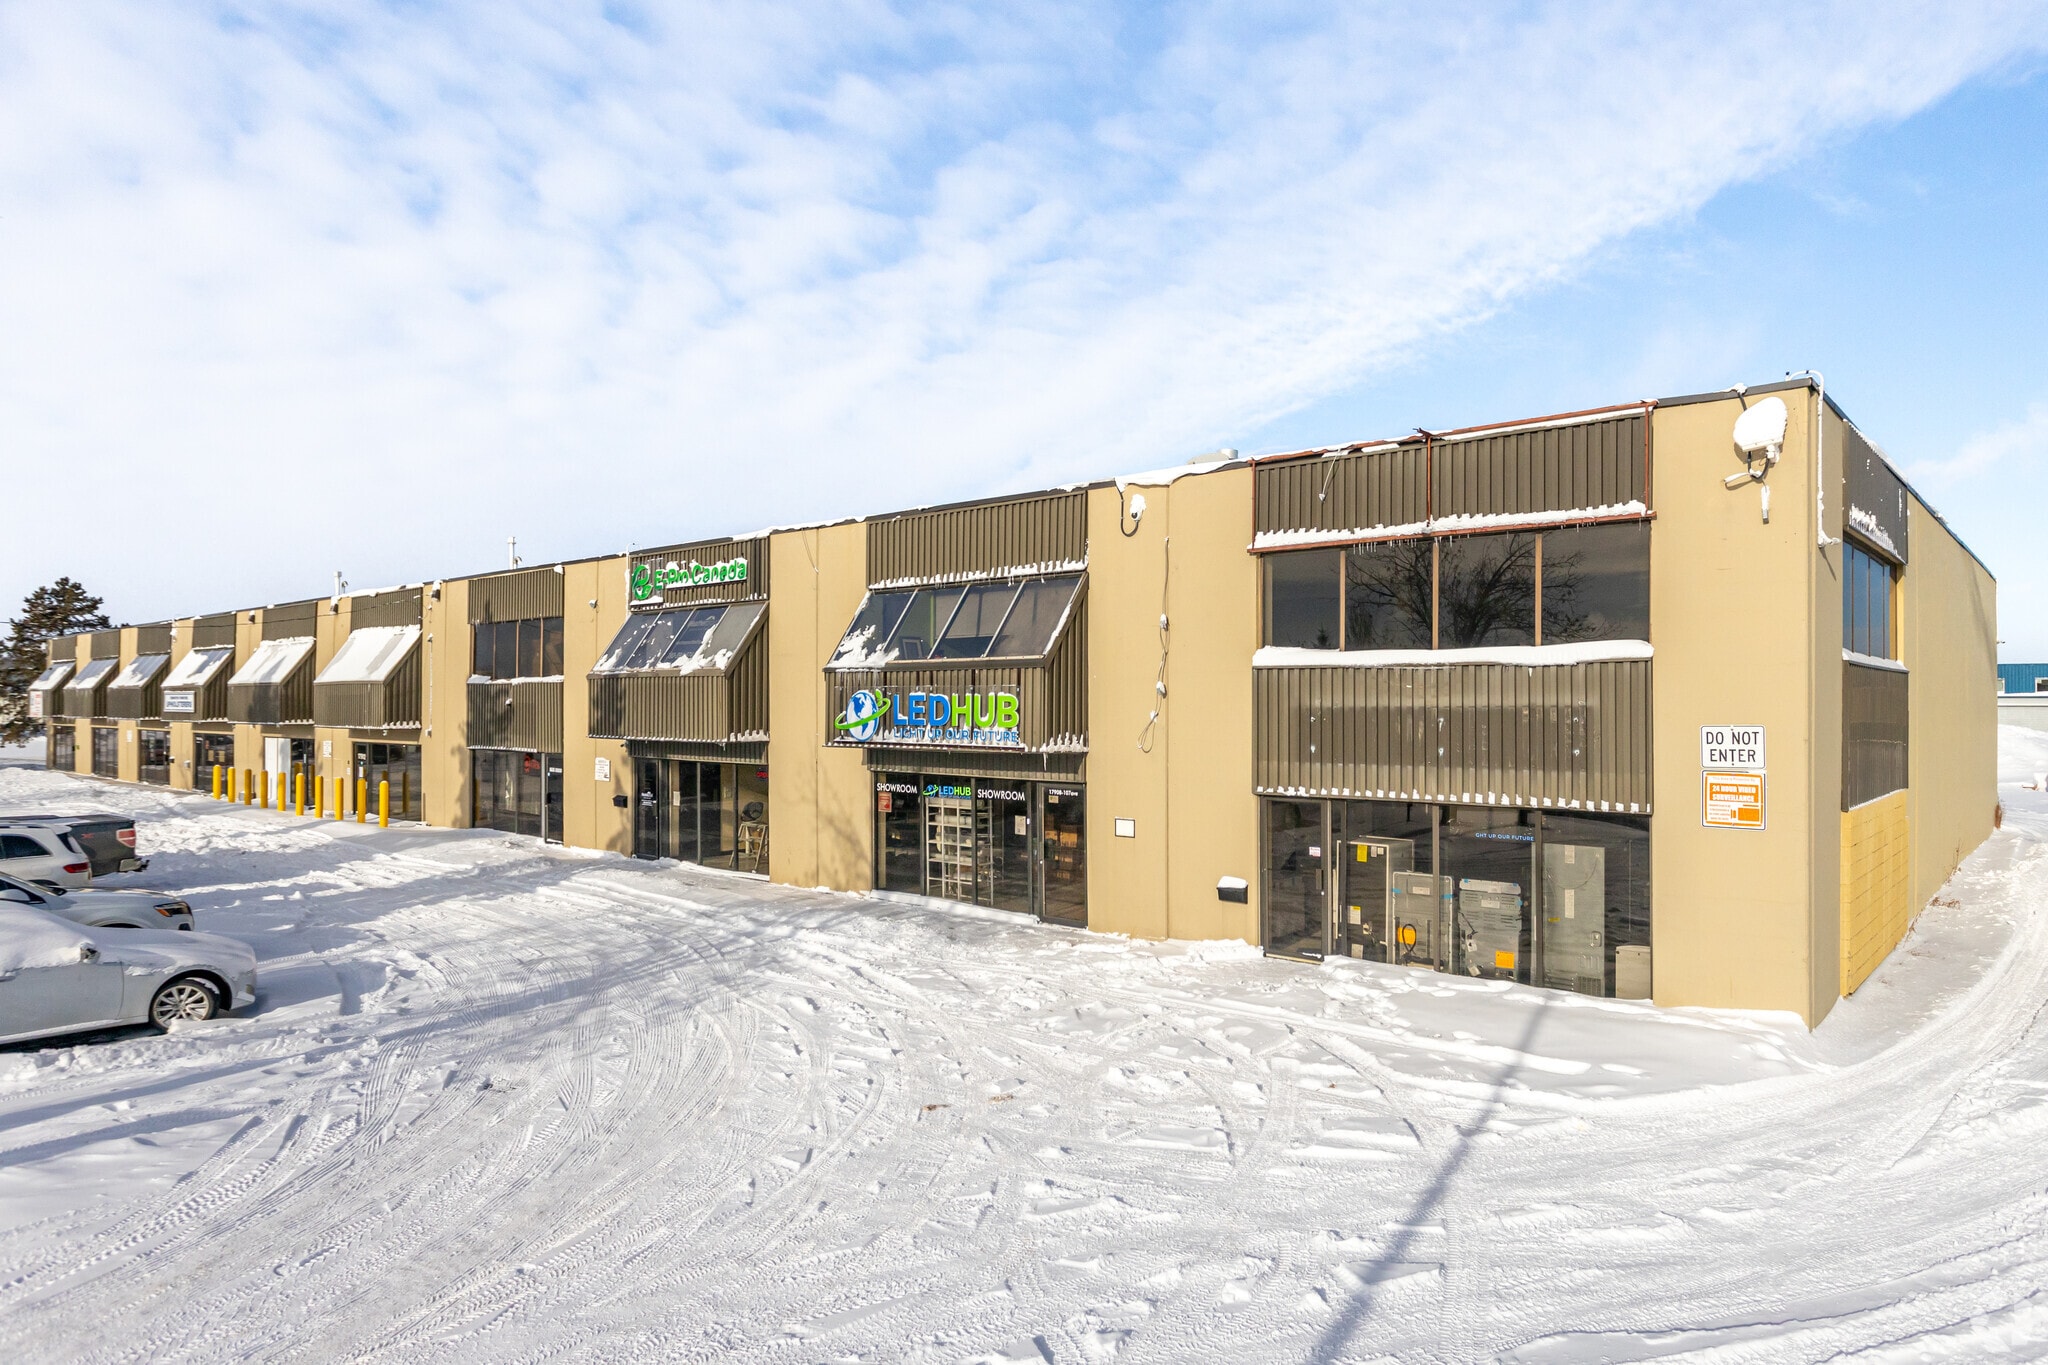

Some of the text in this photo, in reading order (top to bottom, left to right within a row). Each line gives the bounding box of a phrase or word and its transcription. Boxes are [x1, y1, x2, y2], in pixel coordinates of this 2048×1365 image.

[692, 560, 747, 585] Canada
[893, 693, 1020, 728] LEDHUB
[893, 727, 1019, 743] LIGHT UP OUR FUTURE
[1706, 731, 1760, 746] DO NOT
[1709, 748, 1756, 763] ENTER
[876, 782, 918, 794] SHOWROOM
[938, 785, 972, 796] LEDHUB
[1720, 785, 1737, 793] HOUR
[1738, 786, 1756, 794] VIDEO
[977, 789, 1026, 801] SHOWROOM
[1712, 793, 1755, 803] SURVEILLANCE
